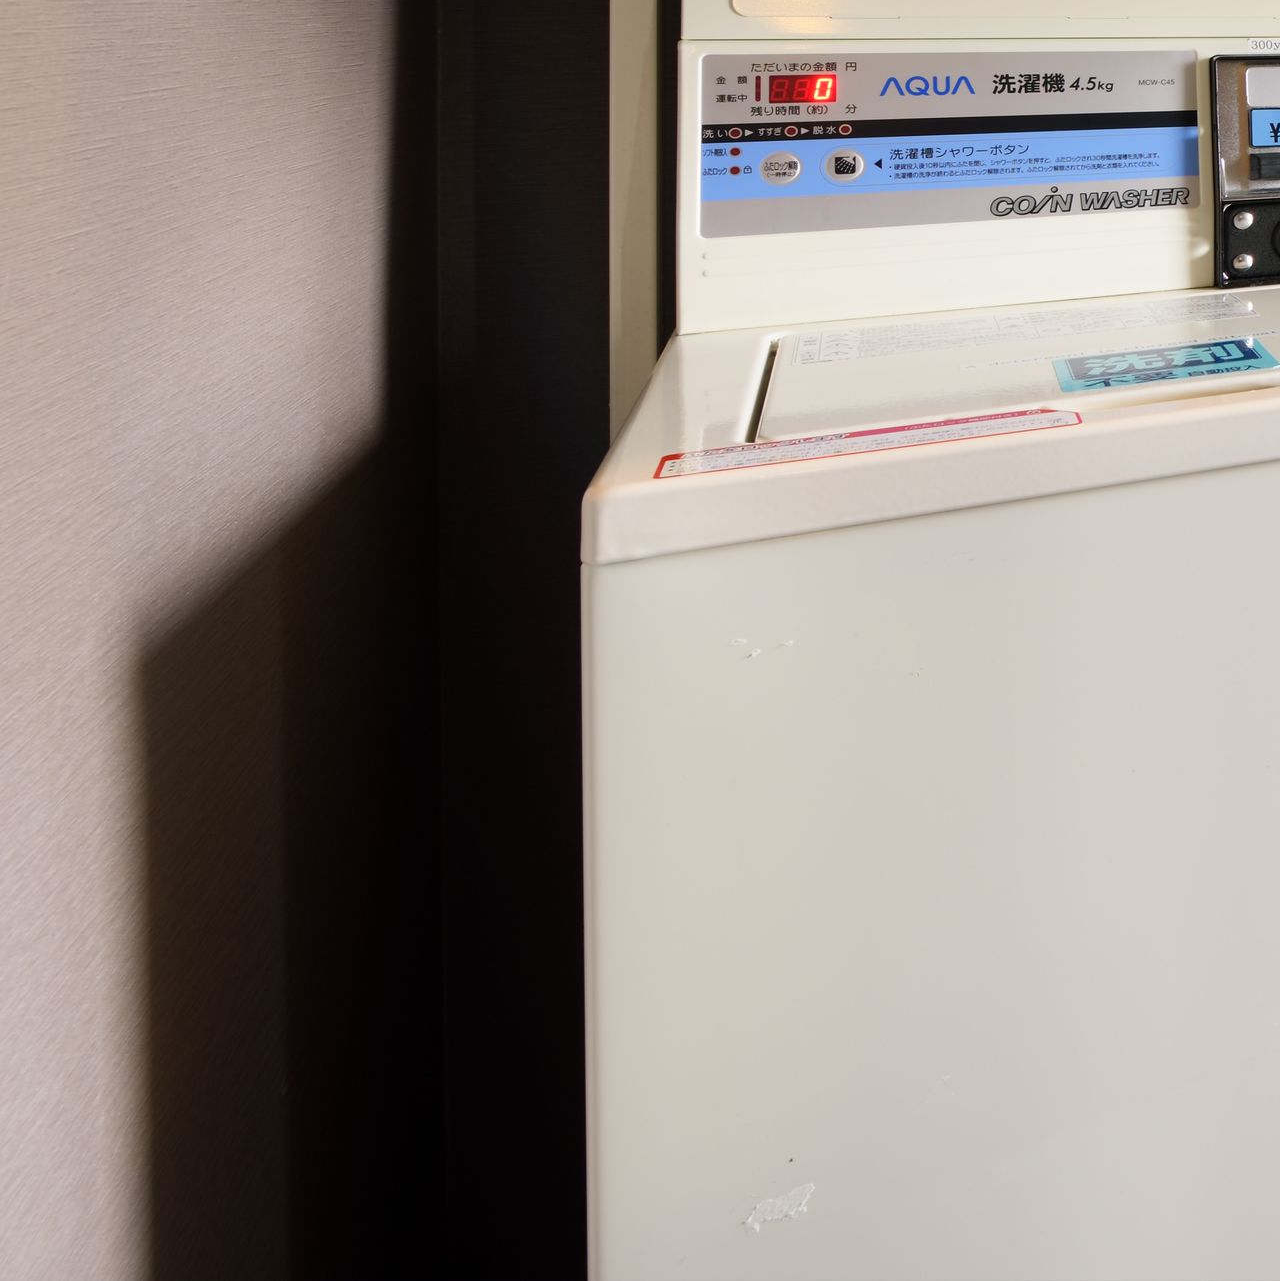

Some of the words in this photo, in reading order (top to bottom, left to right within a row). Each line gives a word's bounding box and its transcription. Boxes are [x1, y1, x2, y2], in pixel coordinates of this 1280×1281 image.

[750, 61, 837, 73] ただいまの金額
[845, 61, 857, 72] 円
[715, 75, 748, 85] 金額
[879, 75, 976, 97] AQUA
[992, 73, 1066, 95] 洗濯機
[715, 94, 748, 103] 運転中
[845, 104, 857, 115] 分
[702, 128, 728, 139] 洗い
[757, 126, 782, 137] すすぎ
[812, 125, 837, 136] 脱水
[889, 143, 1031, 161] 洗濯槽シャワーボタン
[1079, 186, 1191, 211] WASHER
[1083, 343, 1245, 376] 洗剤
